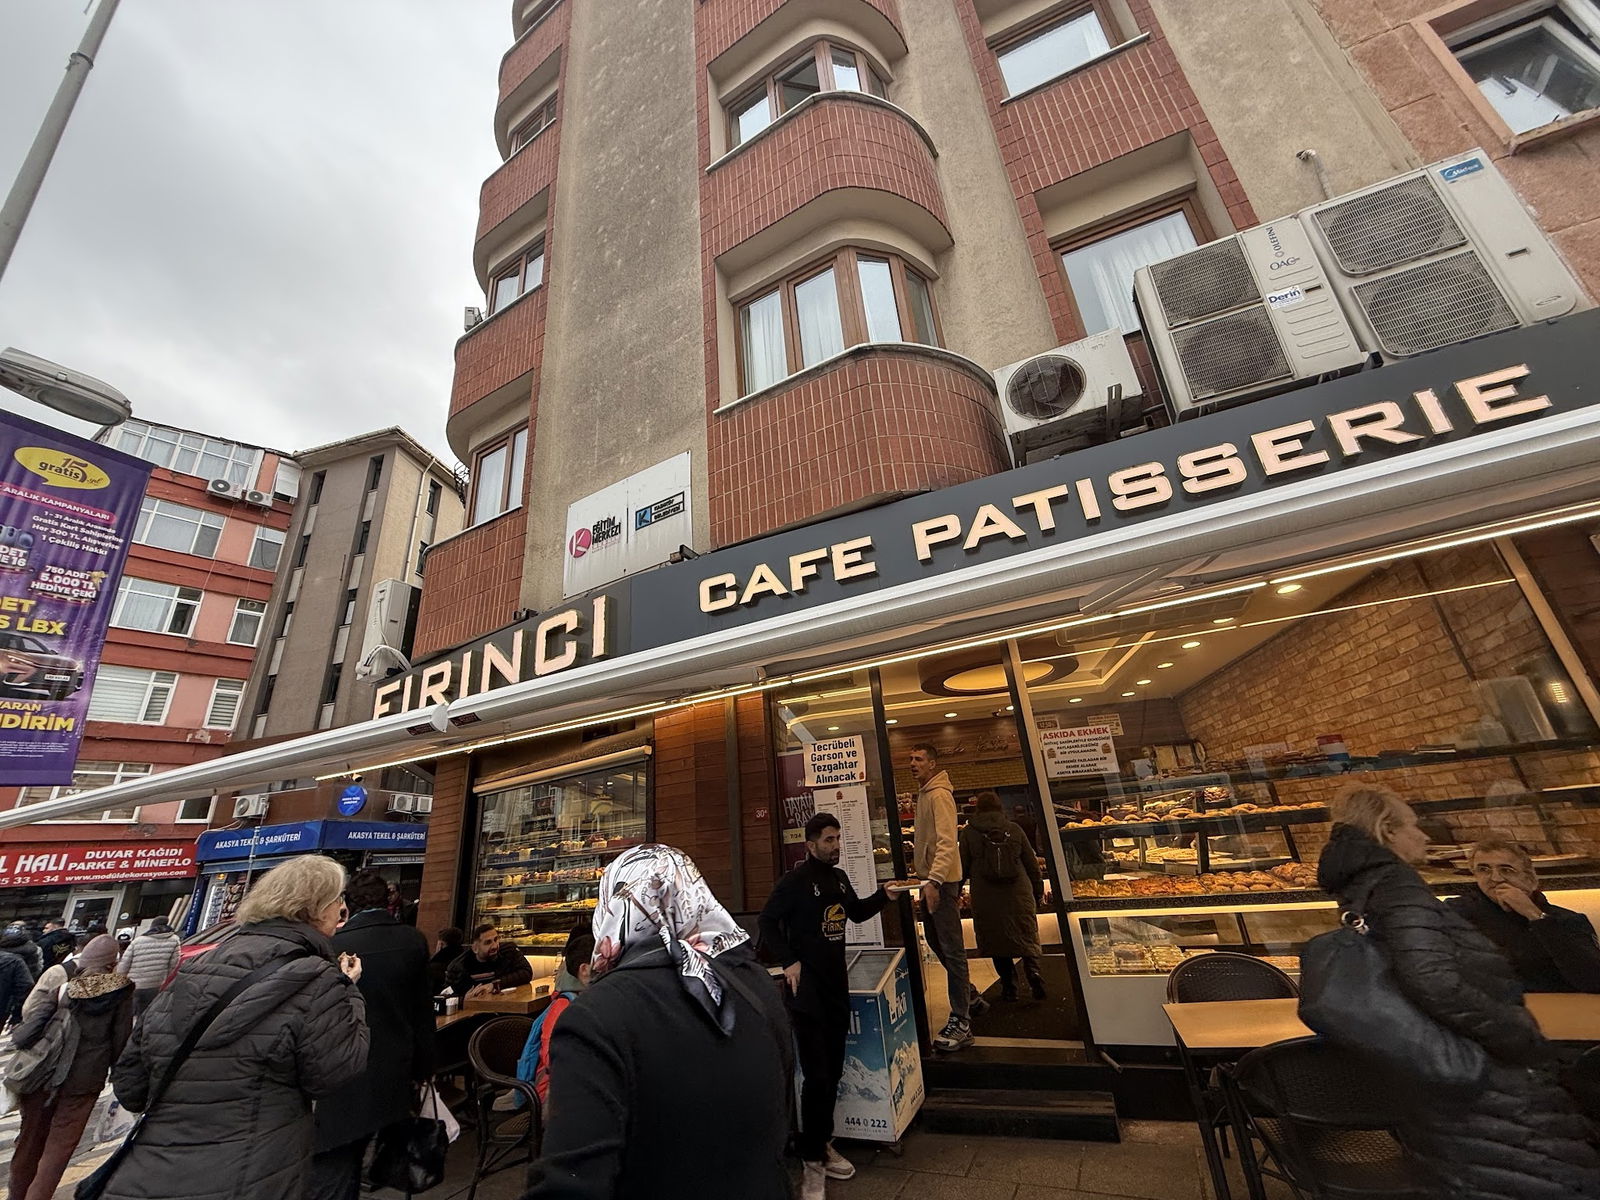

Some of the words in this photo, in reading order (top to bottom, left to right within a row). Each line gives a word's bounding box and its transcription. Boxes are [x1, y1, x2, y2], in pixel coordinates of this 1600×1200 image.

[1268, 287, 1301, 304] Derin
[38, 461, 81, 480] gratis
[60, 457, 89, 483] 15
[3, 486, 40, 501] ARALIK
[41, 496, 110, 520] KAMPANYALARI
[31, 523, 48, 532] Her
[49, 528, 68, 537] 300
[70, 532, 81, 540] TL
[32, 515, 59, 527] Gratis
[59, 522, 78, 532] Kart
[79, 527, 124, 543] Sahiplerine
[592, 515, 616, 535] EĞİTİM
[592, 522, 621, 545] MERKEZİ
[48, 535, 80, 550] Çekiliş
[81, 544, 108, 556] Hakkı
[373, 594, 607, 720] FIRINCI
[698, 535, 877, 614] CAFE
[911, 363, 1553, 562] PATISSERIE
[10, 556, 27, 567] 16
[45, 565, 65, 575] 750
[64, 569, 91, 580] ADET
[39, 573, 80, 587] 5.000
[81, 581, 97, 590] TL
[31, 581, 71, 595] HEDİYE
[71, 588, 97, 600] ÇEKİ
[16, 617, 68, 636] LBX
[1043, 731, 1076, 741] ASKIDA
[1077, 727, 1109, 737] EKMEK
[811, 738, 856, 752] Tecrübeli
[810, 750, 844, 763] Garson
[846, 750, 858, 759] ve
[811, 761, 859, 774] Tezgahtar
[815, 772, 857, 785] Alınacak
[214, 839, 240, 850] AKASYA
[265, 831, 302, 846] ŞARKÜTERİ
[347, 831, 374, 840] AKASYA
[373, 831, 391, 840] TEKEL
[396, 830, 426, 842] ŞARKÜTERİ
[84, 850, 138, 860] DUVAR
[138, 847, 183, 859] KAĞIDI
[14, 853, 69, 875] HALI
[67, 861, 116, 871] PARKE
[119, 860, 130, 869] &
[133, 857, 192, 868] MİNEFLO
[13, 876, 31, 885] 33
[42, 875, 60, 884] 34
[844, 1116, 861, 1126] 444
[863, 1118, 868, 1127] 0
[870, 1118, 888, 1128] 222
